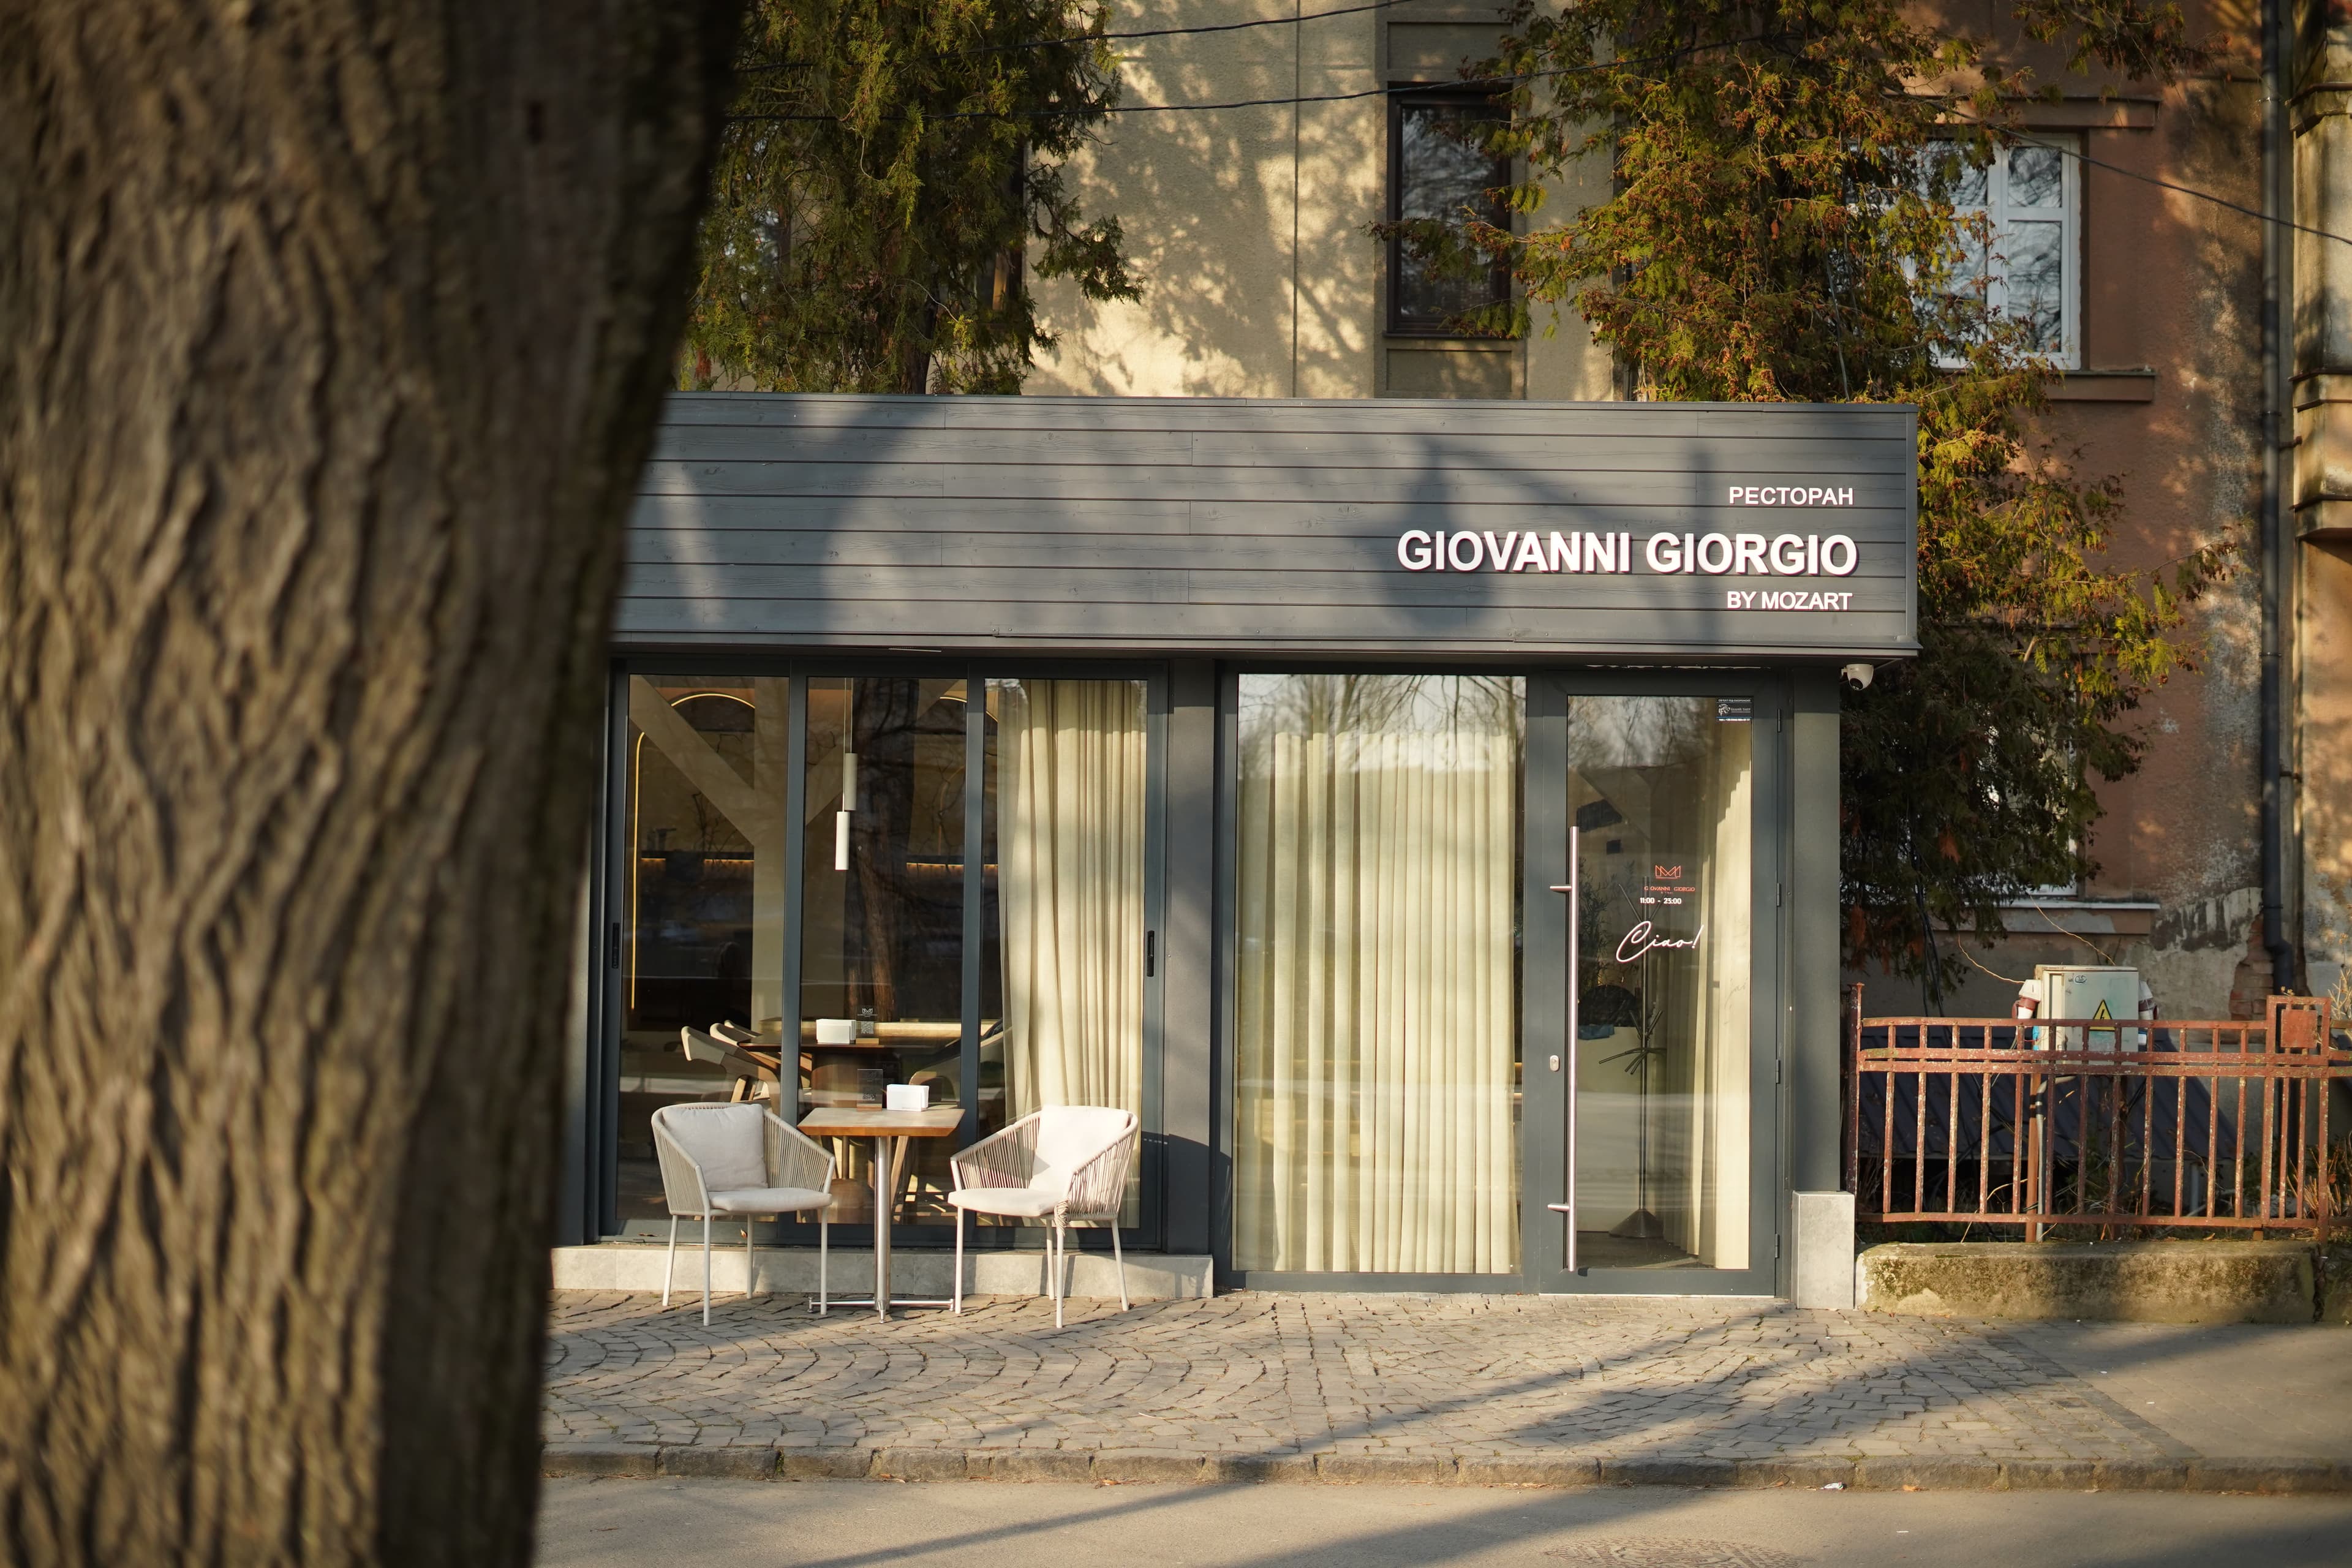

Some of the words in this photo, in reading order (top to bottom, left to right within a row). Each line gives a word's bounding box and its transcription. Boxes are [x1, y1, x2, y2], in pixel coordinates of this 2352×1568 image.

[1729, 486, 1853, 506] РЕСТОРАН
[1397, 530, 1630, 573] GIOVANNI
[1646, 532, 1858, 576] GIORGIO
[1727, 590, 1756, 609] BY
[1761, 591, 1853, 610] MOZART
[1616, 921, 1705, 962] Ciao!
